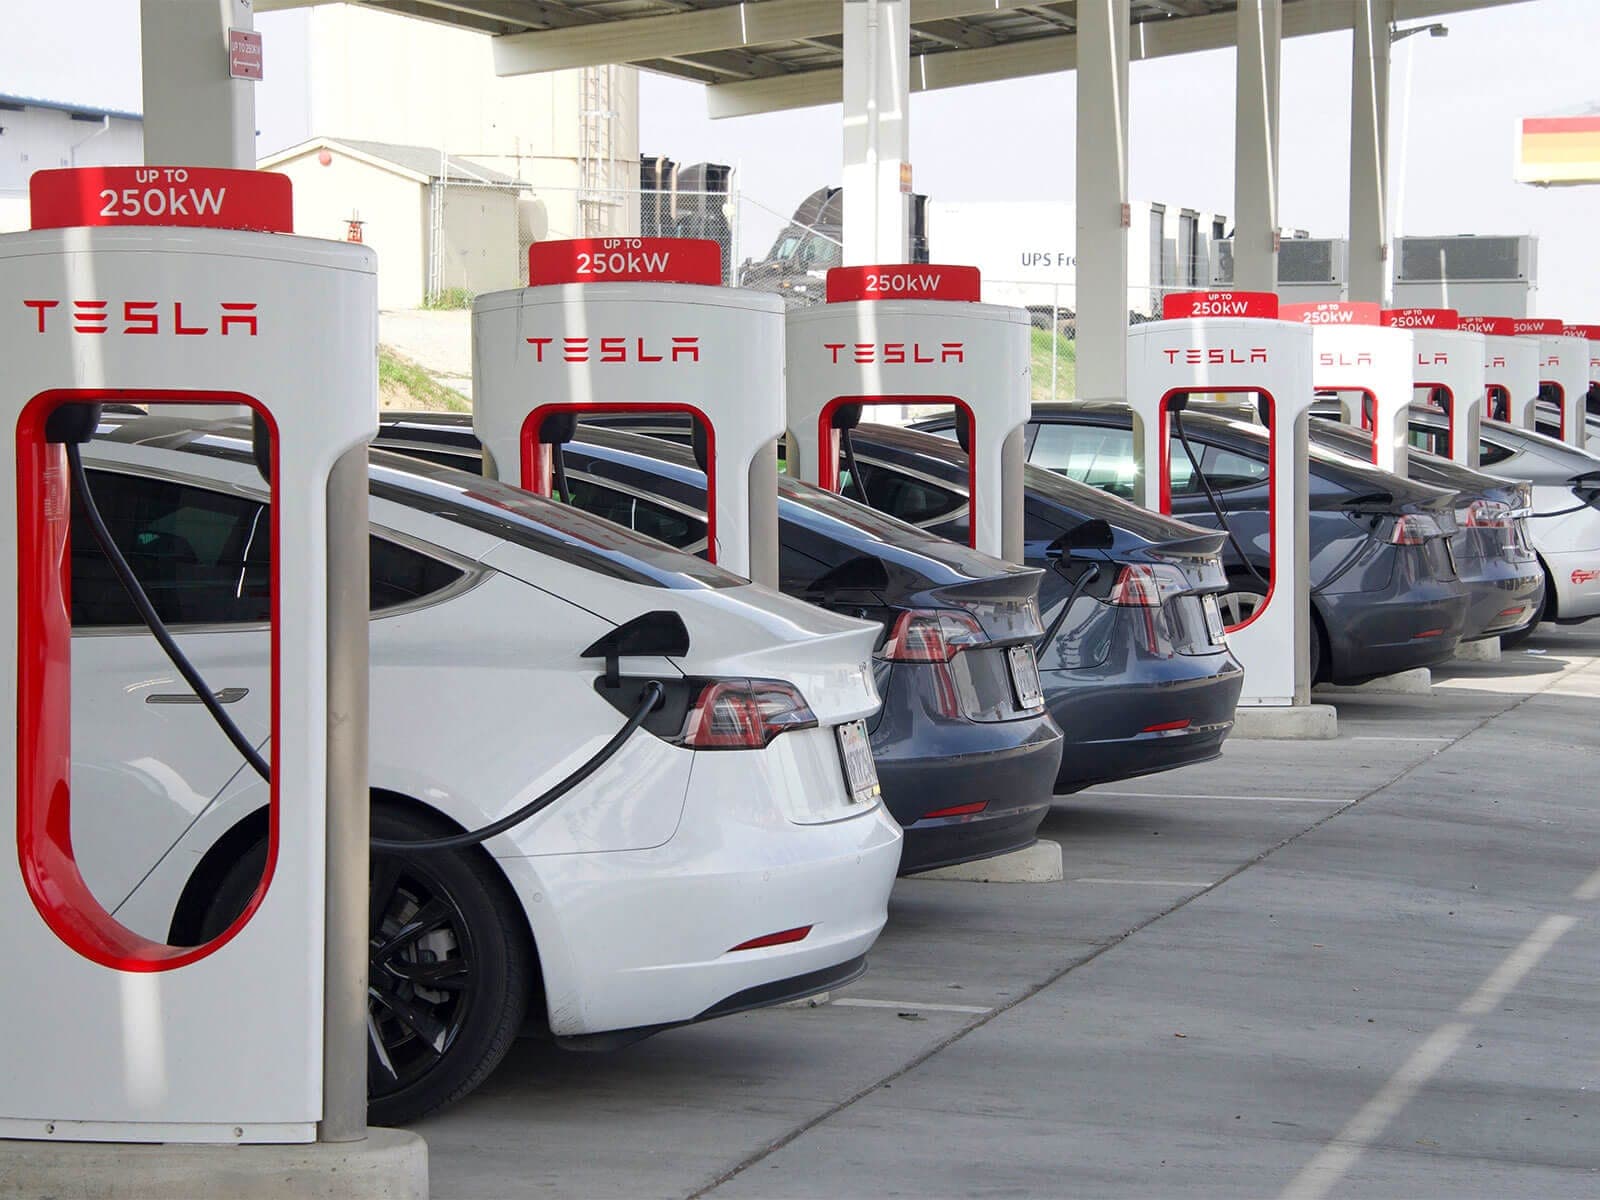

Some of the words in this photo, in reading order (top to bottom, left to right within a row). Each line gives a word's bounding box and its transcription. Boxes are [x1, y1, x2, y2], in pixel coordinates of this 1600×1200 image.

[135, 169, 159, 183] UP
[163, 169, 188, 183] TO
[99, 187, 226, 216] 250kW
[603, 239, 621, 249] UP
[624, 239, 642, 249] TO
[576, 252, 670, 273] 250kW
[1022, 252, 1052, 267] UPS
[865, 274, 941, 292] 250kW
[1208, 293, 1219, 301] UP
[1220, 293, 1232, 301] TO
[1191, 301, 1248, 315] 250kW
[24, 300, 258, 336] TESLA
[1303, 311, 1353, 323] 250kW
[1391, 315, 1435, 327] 250kW
[527, 337, 700, 362] TESLA
[825, 343, 964, 365] TESLA
[1163, 348, 1267, 364] TESLA
